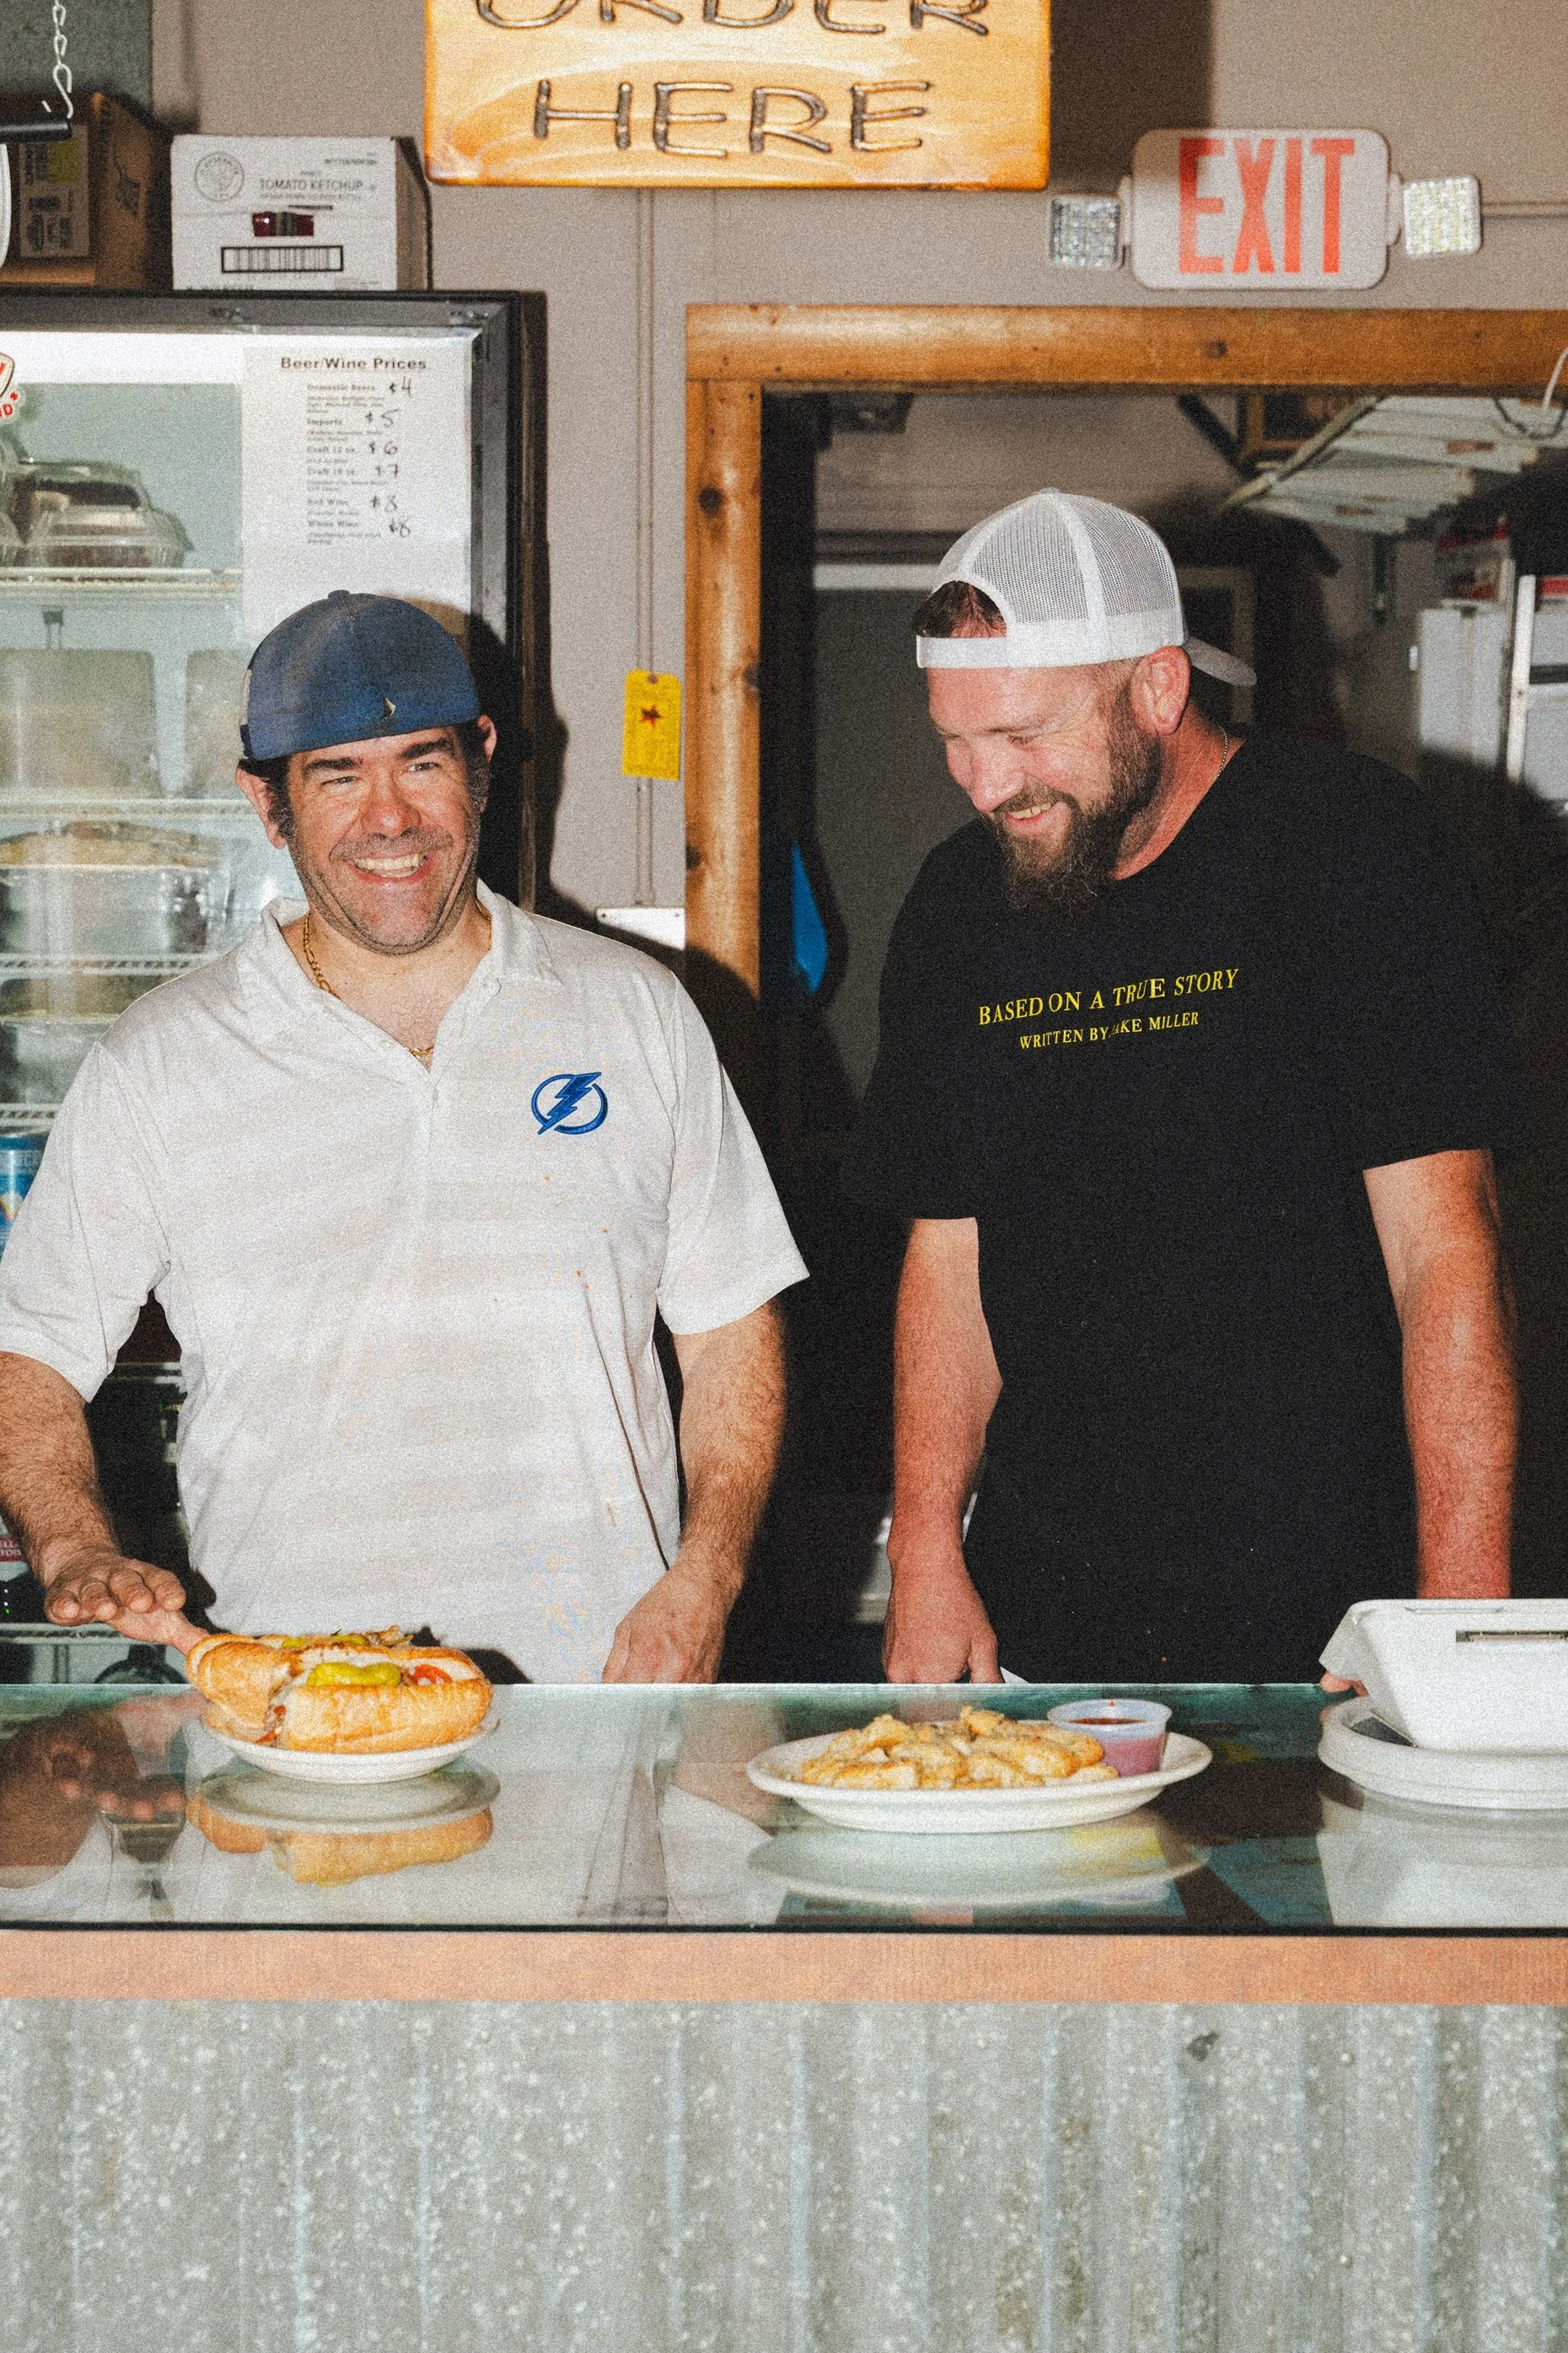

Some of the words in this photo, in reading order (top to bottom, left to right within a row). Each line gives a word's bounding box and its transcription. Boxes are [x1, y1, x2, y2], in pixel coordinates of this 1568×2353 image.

[533, 79, 933, 158] HERE
[260, 179, 308, 191] TOMATO
[311, 179, 364, 191] KETCHUP
[1179, 137, 1356, 273] EXIT
[373, 357, 427, 369] Prices
[979, 997, 1044, 1025] BASED
[1049, 991, 1082, 1013] ON
[1088, 991, 1105, 1009] A
[1113, 978, 1166, 1007] TRUE
[1173, 968, 1239, 996] STORY
[1019, 1029, 1084, 1050] WRITTEN
[1089, 1026, 1109, 1041] BY
[1148, 1012, 1200, 1031] MILLER
